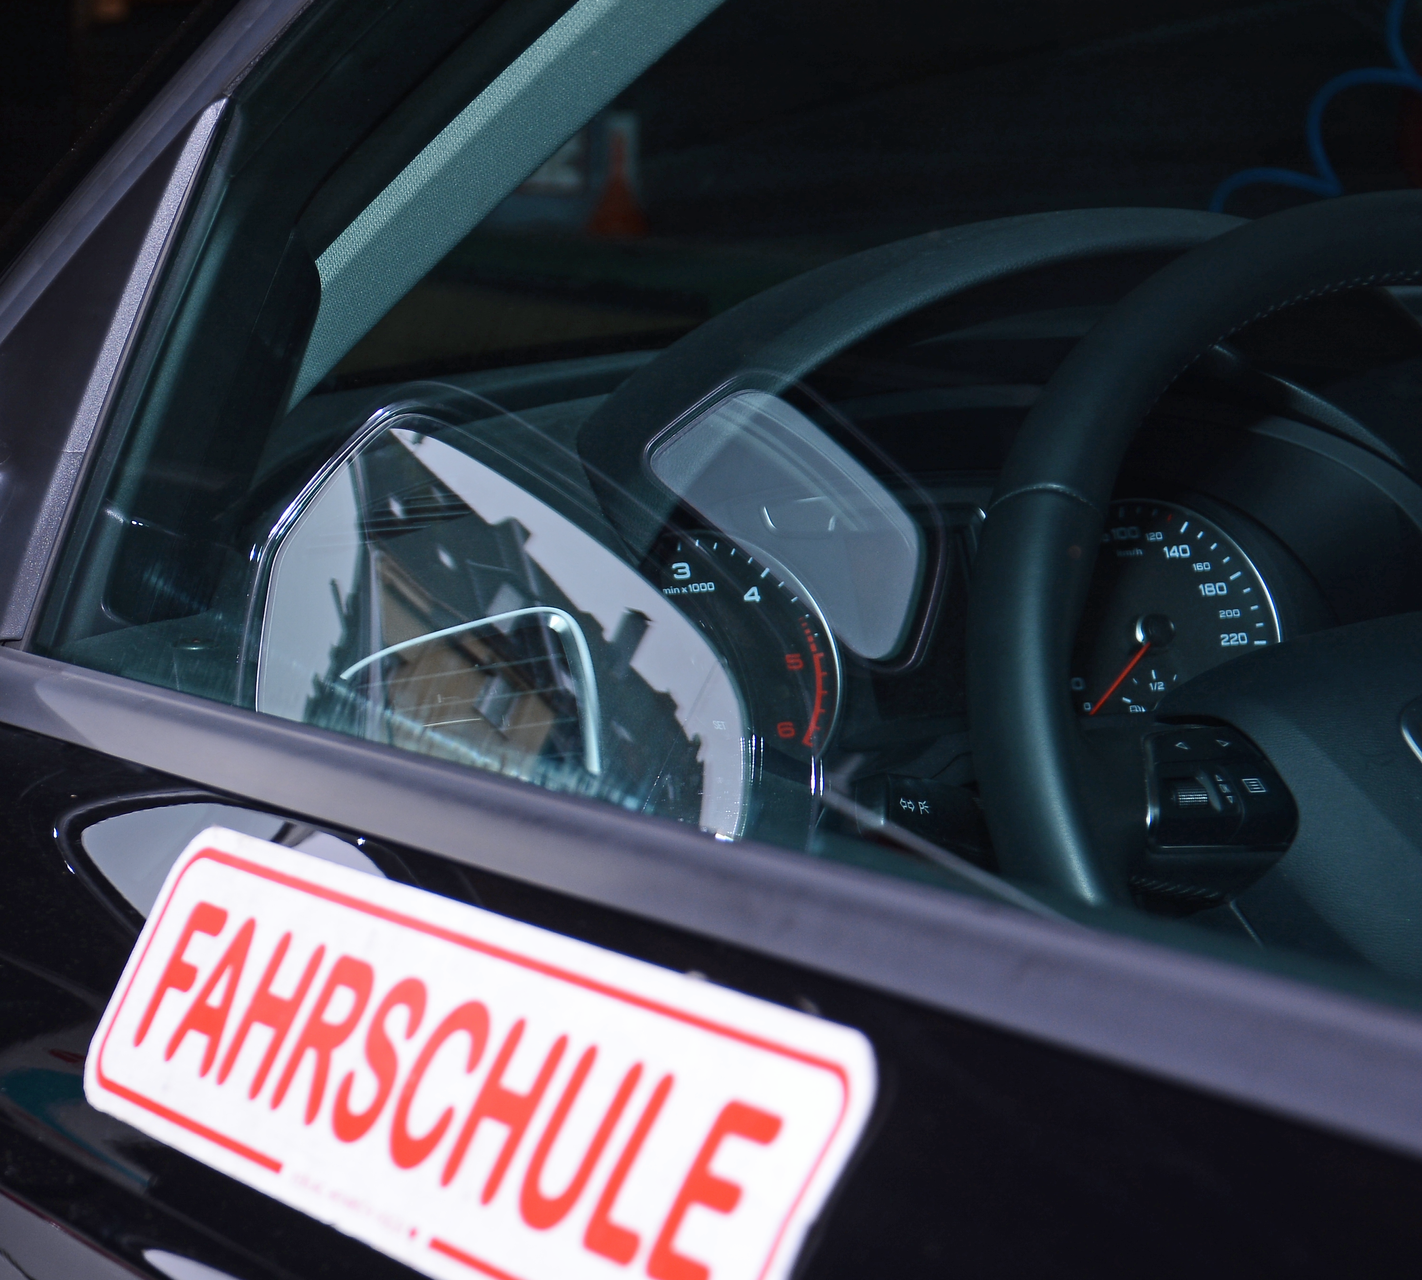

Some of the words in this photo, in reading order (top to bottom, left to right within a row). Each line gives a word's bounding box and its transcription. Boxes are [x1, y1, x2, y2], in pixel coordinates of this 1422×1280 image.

[1111, 526, 1140, 540] 100
[1145, 531, 1163, 542] 120
[1162, 544, 1191, 560] 140
[671, 562, 691, 580] 3
[1192, 561, 1211, 572] 160
[743, 586, 761, 603] 4
[1198, 582, 1228, 597] 180
[1218, 608, 1241, 619] 200
[1220, 632, 1249, 646] 220
[785, 653, 804, 671] 5
[1148, 682, 1165, 691] 1/2
[712, 720, 726, 731] SET
[777, 721, 796, 738] 6
[133, 901, 783, 1280] FAHRSCHULE
